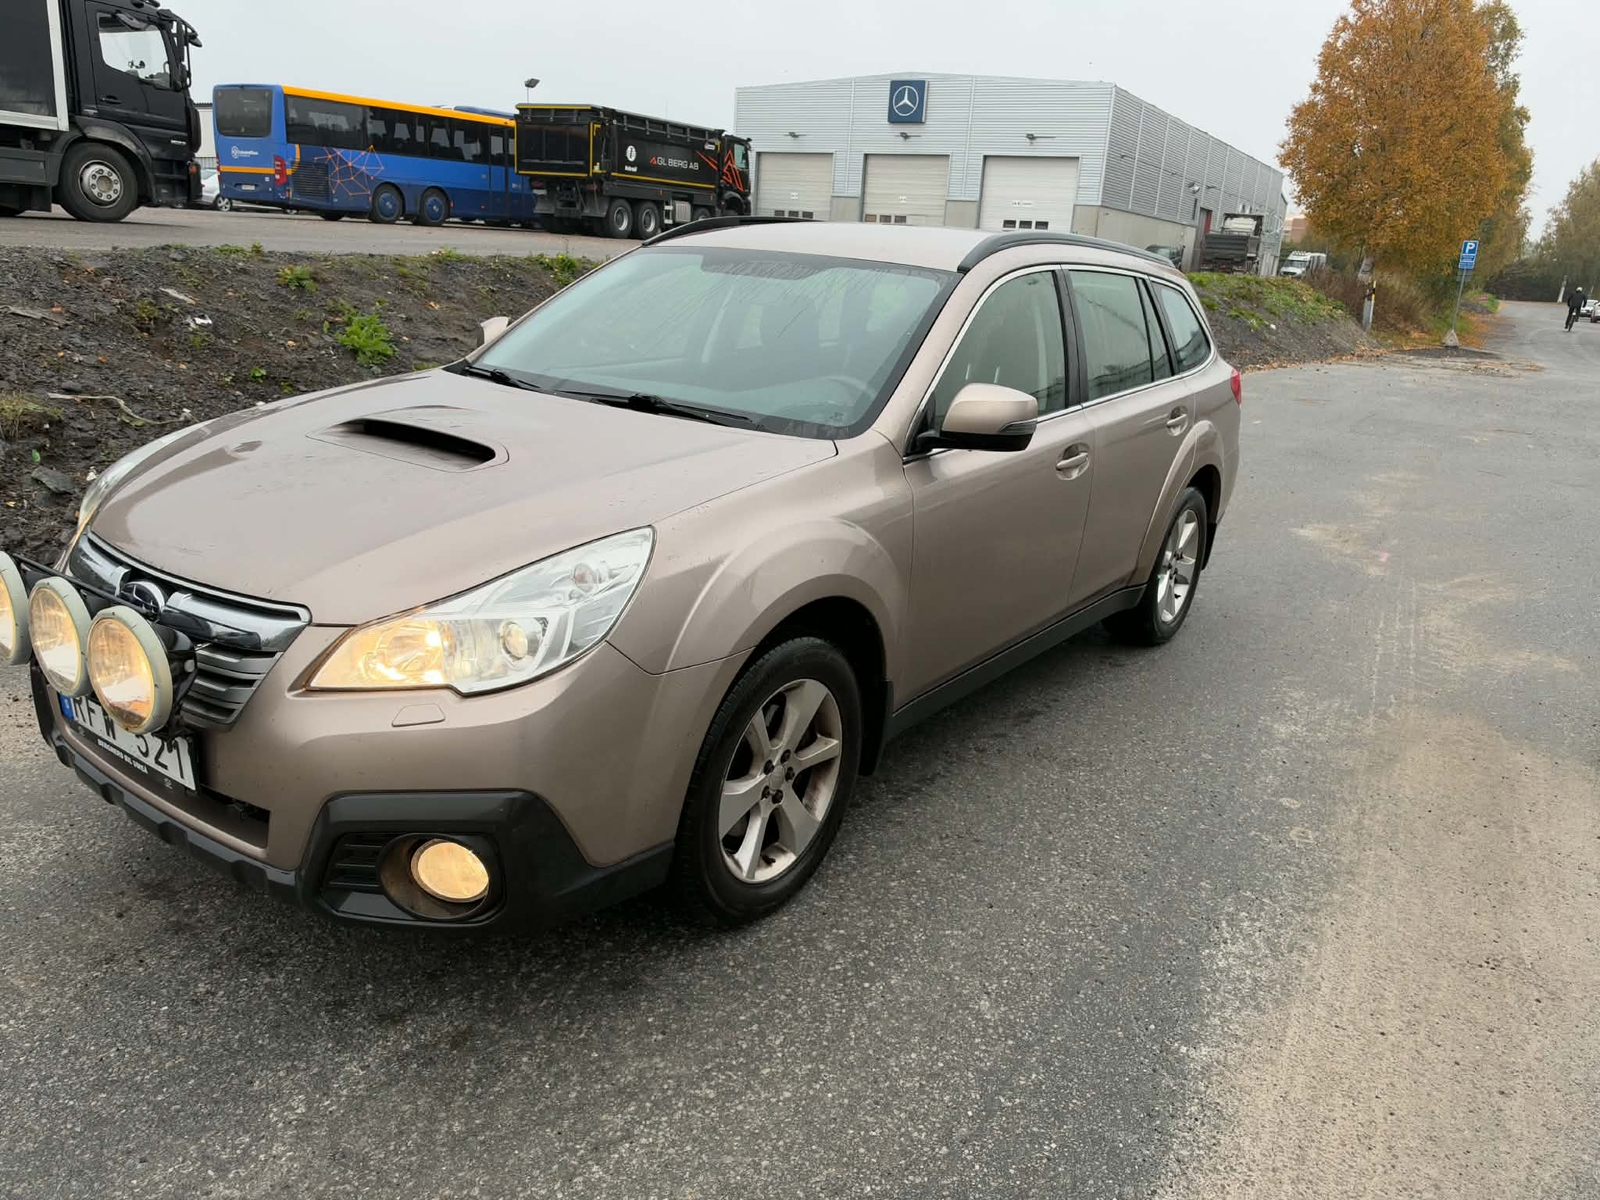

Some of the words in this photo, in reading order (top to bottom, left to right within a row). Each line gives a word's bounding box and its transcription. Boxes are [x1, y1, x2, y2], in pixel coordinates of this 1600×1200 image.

[667, 158, 688, 169] BERG
[689, 162, 699, 170] AB
[1465, 242, 1476, 254] P
